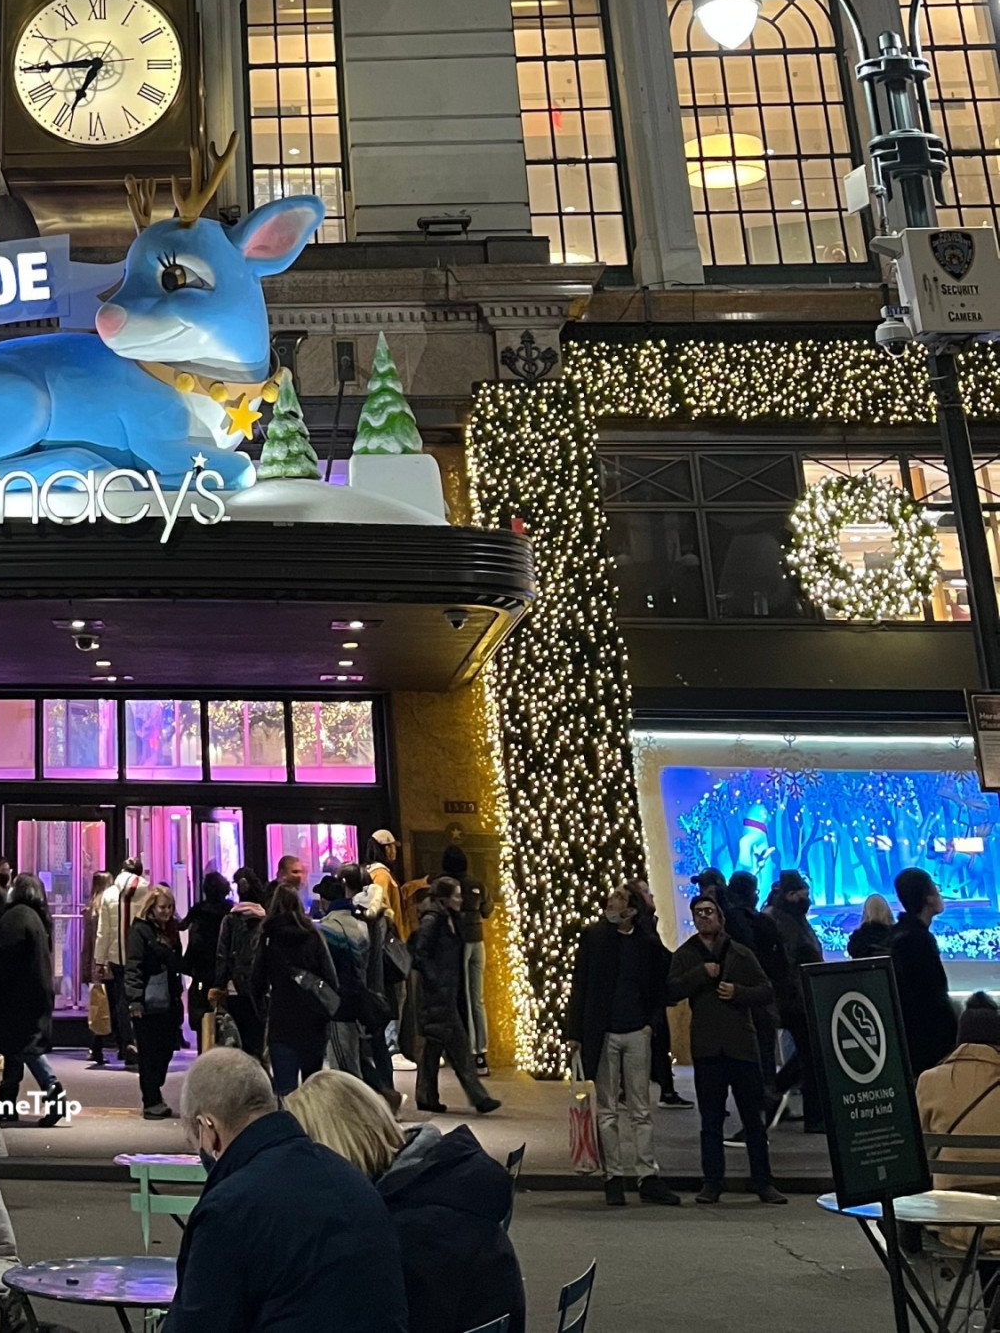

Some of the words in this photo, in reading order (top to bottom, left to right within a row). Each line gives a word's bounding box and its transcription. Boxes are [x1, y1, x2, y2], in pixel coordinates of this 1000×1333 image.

[941, 283, 979, 296] SECURITY
[948, 311, 983, 322] CAMERA
[842, 1093, 856, 1105] NO
[857, 1087, 895, 1103] SMOKING
[850, 1107, 859, 1120] of
[860, 1108, 874, 1119] any
[875, 1102, 893, 1115] kind
